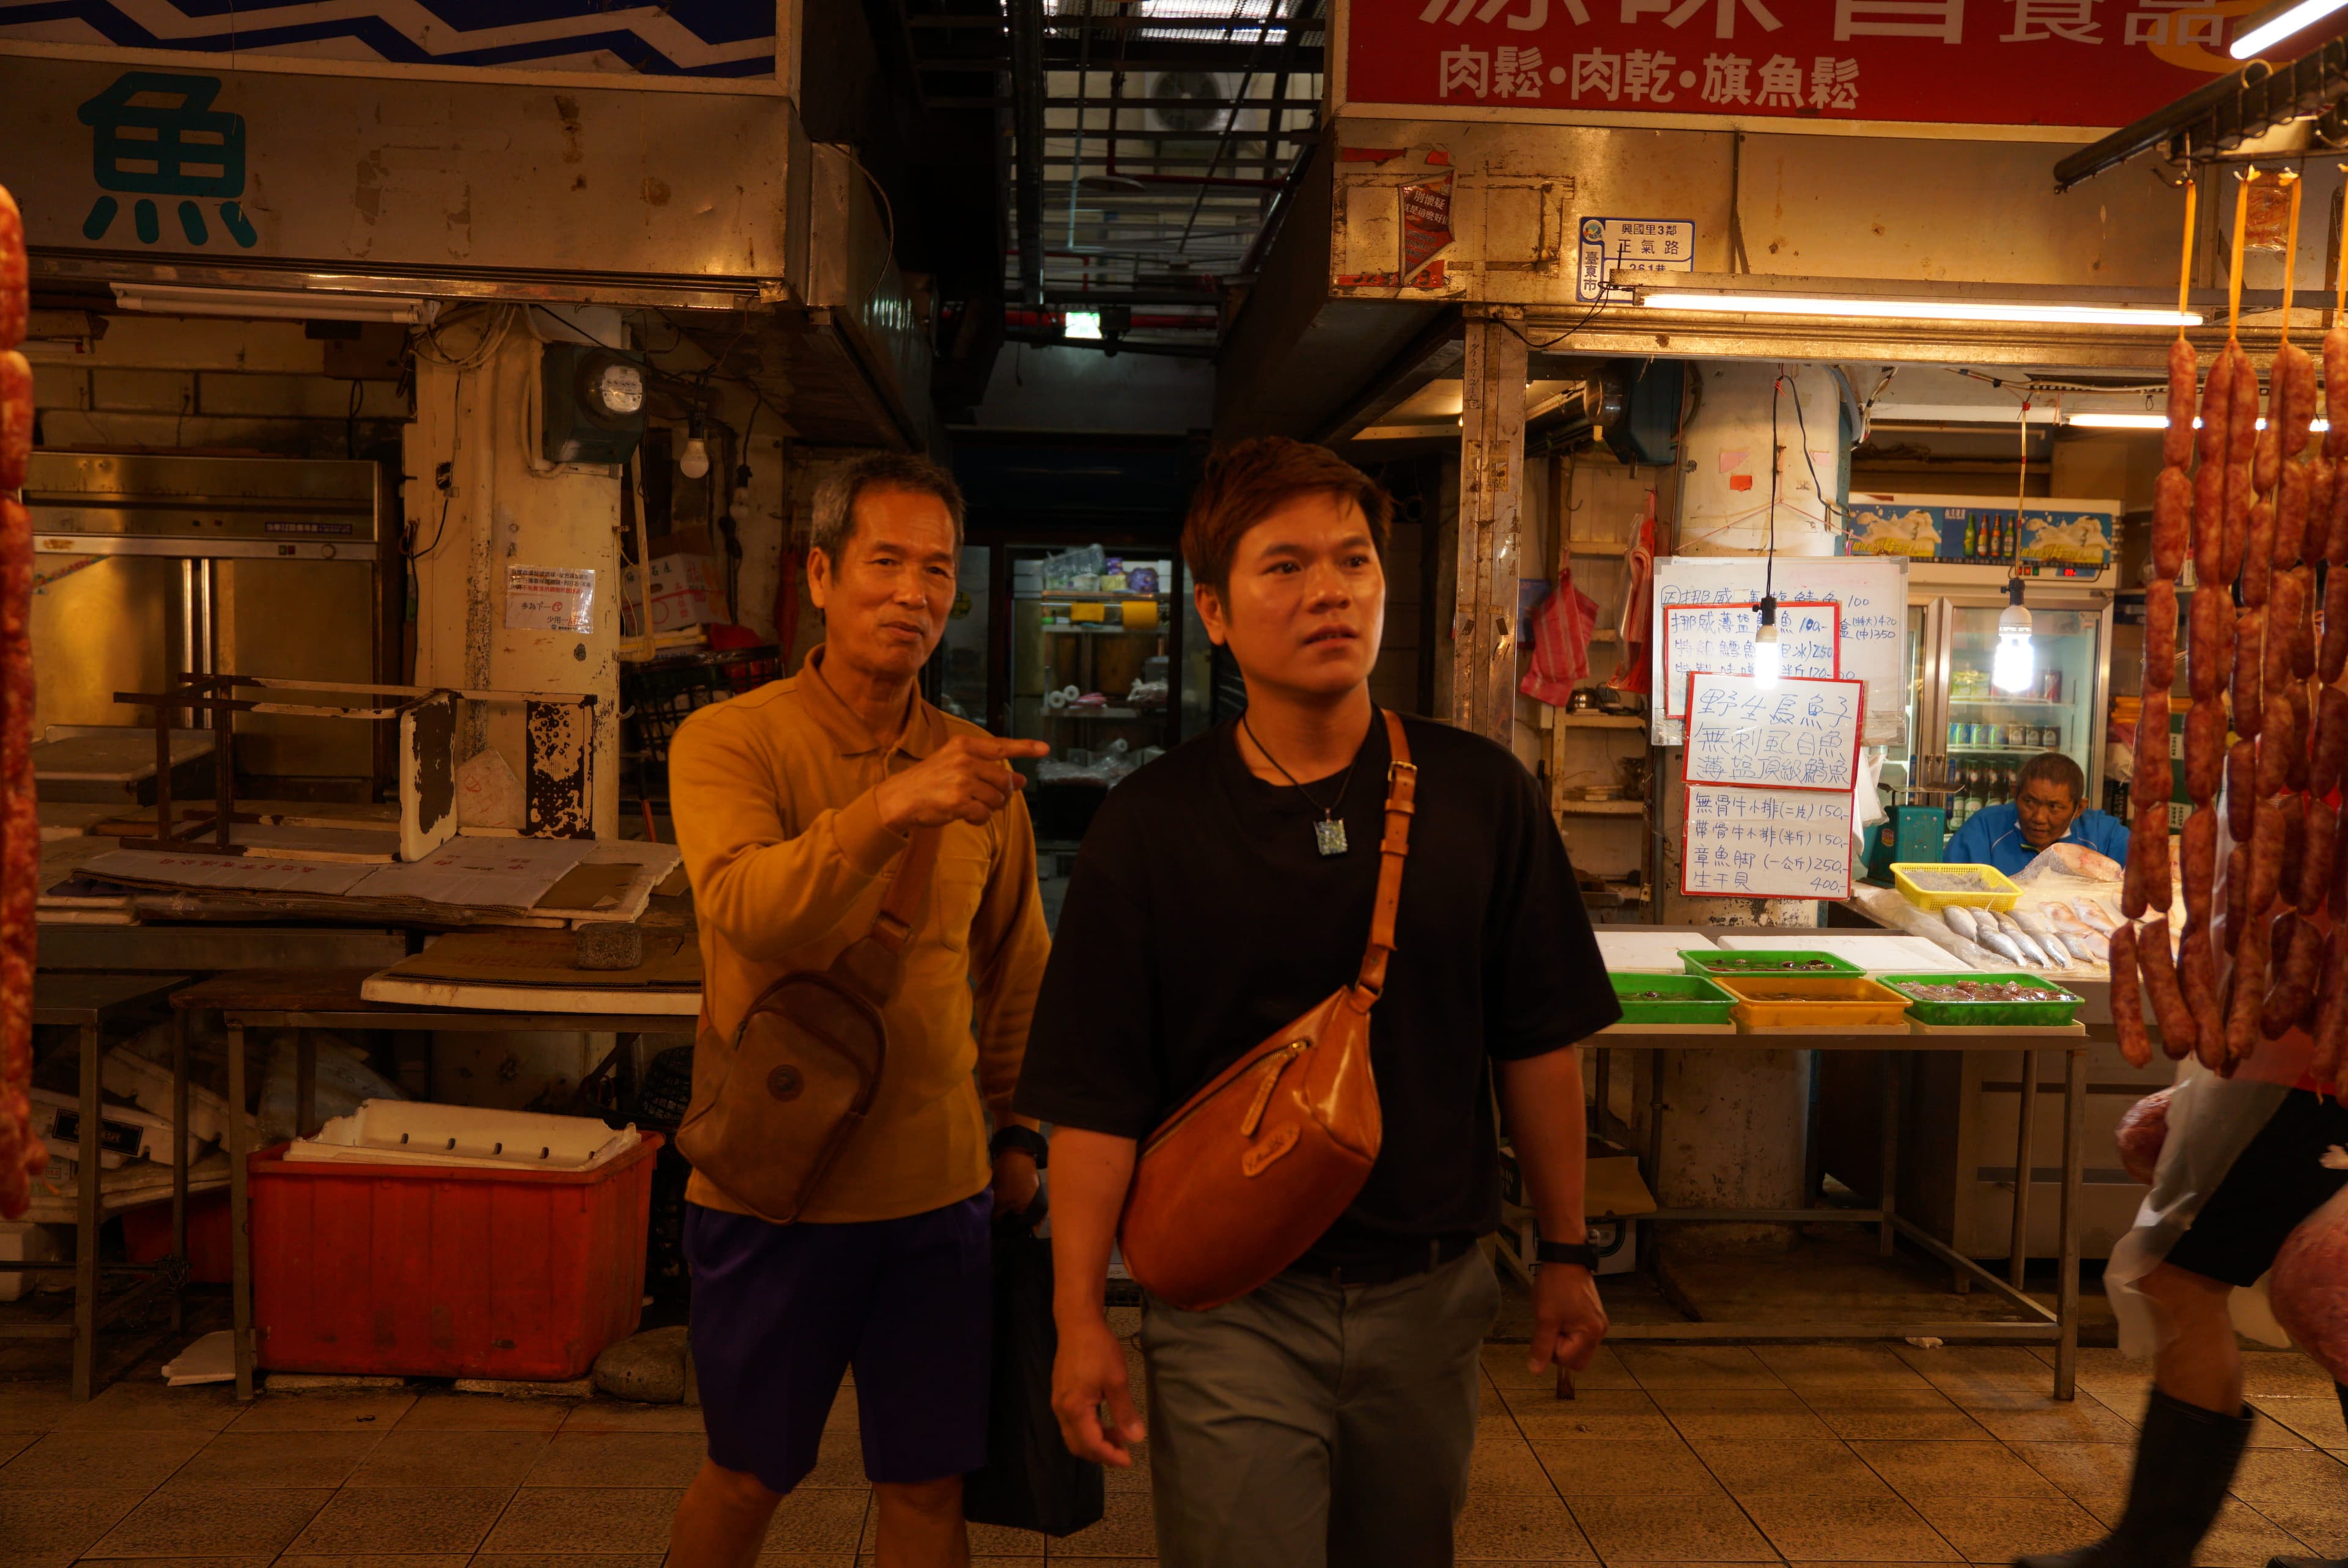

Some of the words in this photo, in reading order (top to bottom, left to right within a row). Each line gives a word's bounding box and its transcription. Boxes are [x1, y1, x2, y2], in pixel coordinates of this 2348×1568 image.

[1439, 43, 1861, 110] 肉鬆•肉乾•旗魚鬆
[77, 71, 258, 249] 魚
[1413, 190, 1445, 210] 別懷疑
[1622, 224, 1677, 236] 興國里3鄰
[1617, 238, 1679, 255] 正氣路
[1583, 251, 1598, 292] 臺東市
[1848, 595, 1869, 608] 100
[1879, 614, 1897, 626] 420
[1874, 629, 1896, 639] 350
[1693, 870, 1754, 892] 生干貝
